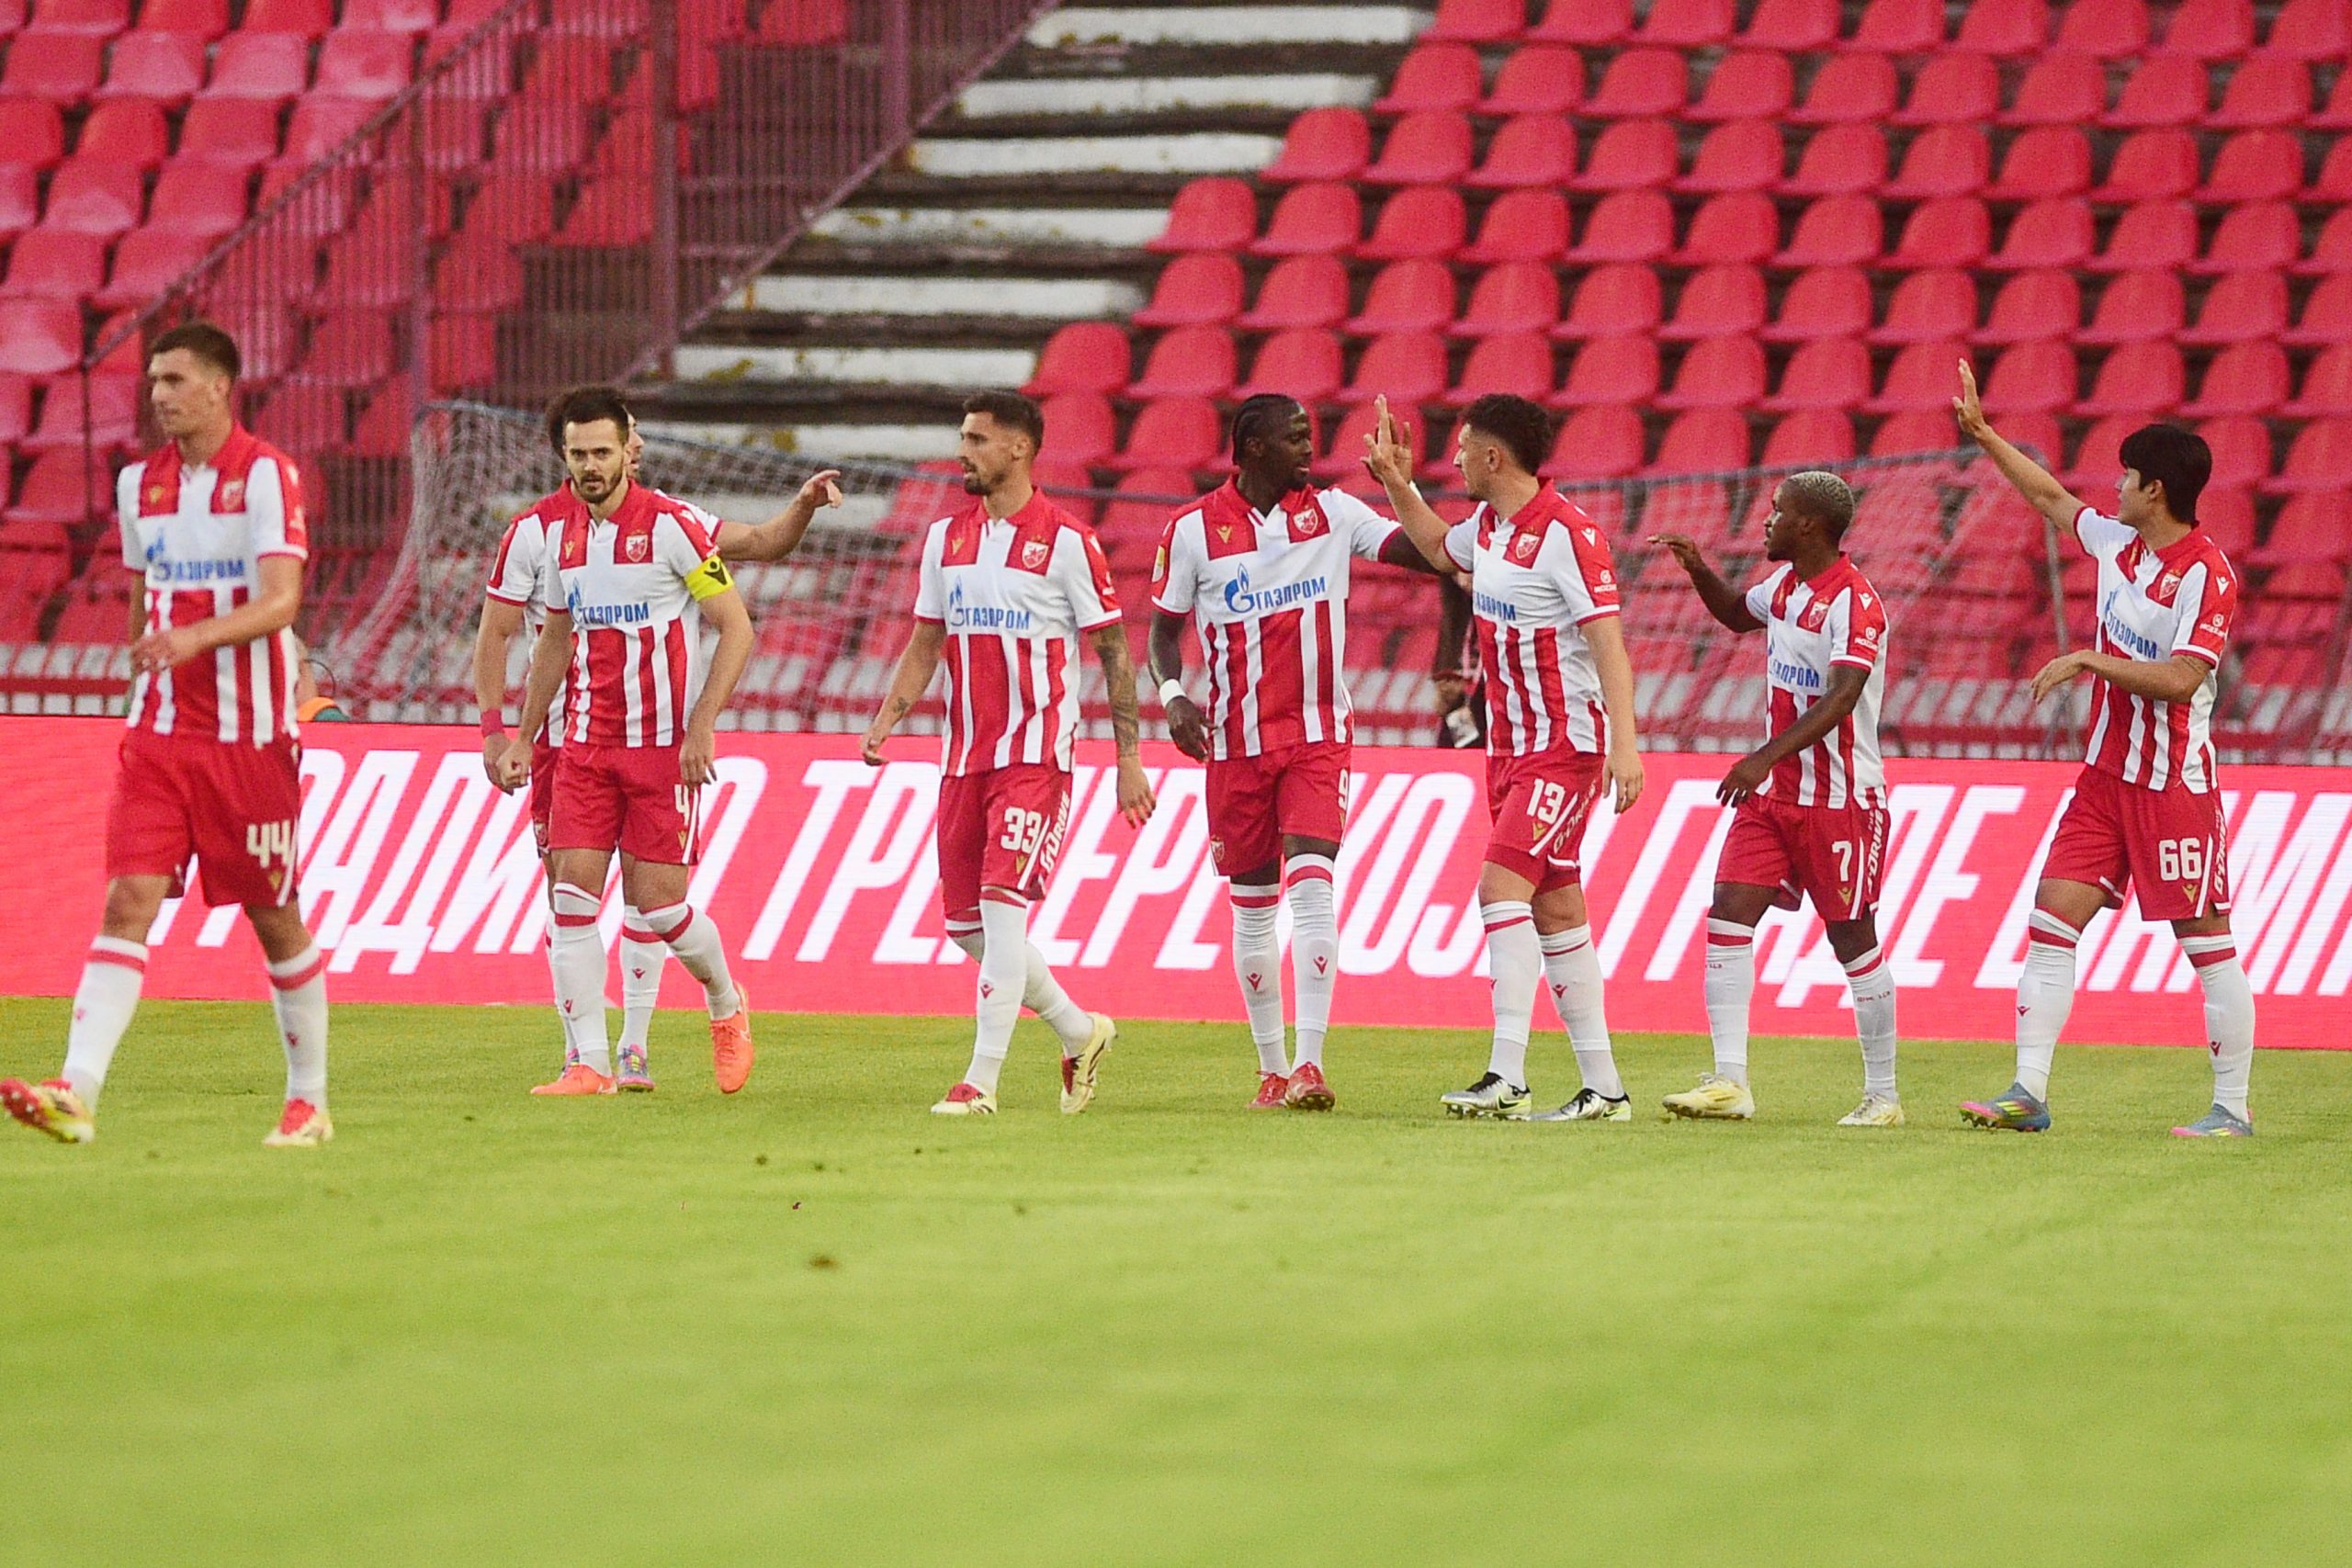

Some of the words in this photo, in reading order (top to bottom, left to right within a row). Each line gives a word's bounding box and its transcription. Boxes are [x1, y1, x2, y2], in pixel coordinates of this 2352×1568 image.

[1255, 576, 1326, 610] ГАЗПРОМ
[674, 783, 690, 826] 4
[1526, 778, 1566, 825] 13
[246, 820, 292, 869] 44
[1000, 806, 1042, 854] 33
[1831, 840, 1853, 882] 7
[2158, 837, 2203, 882] 66
